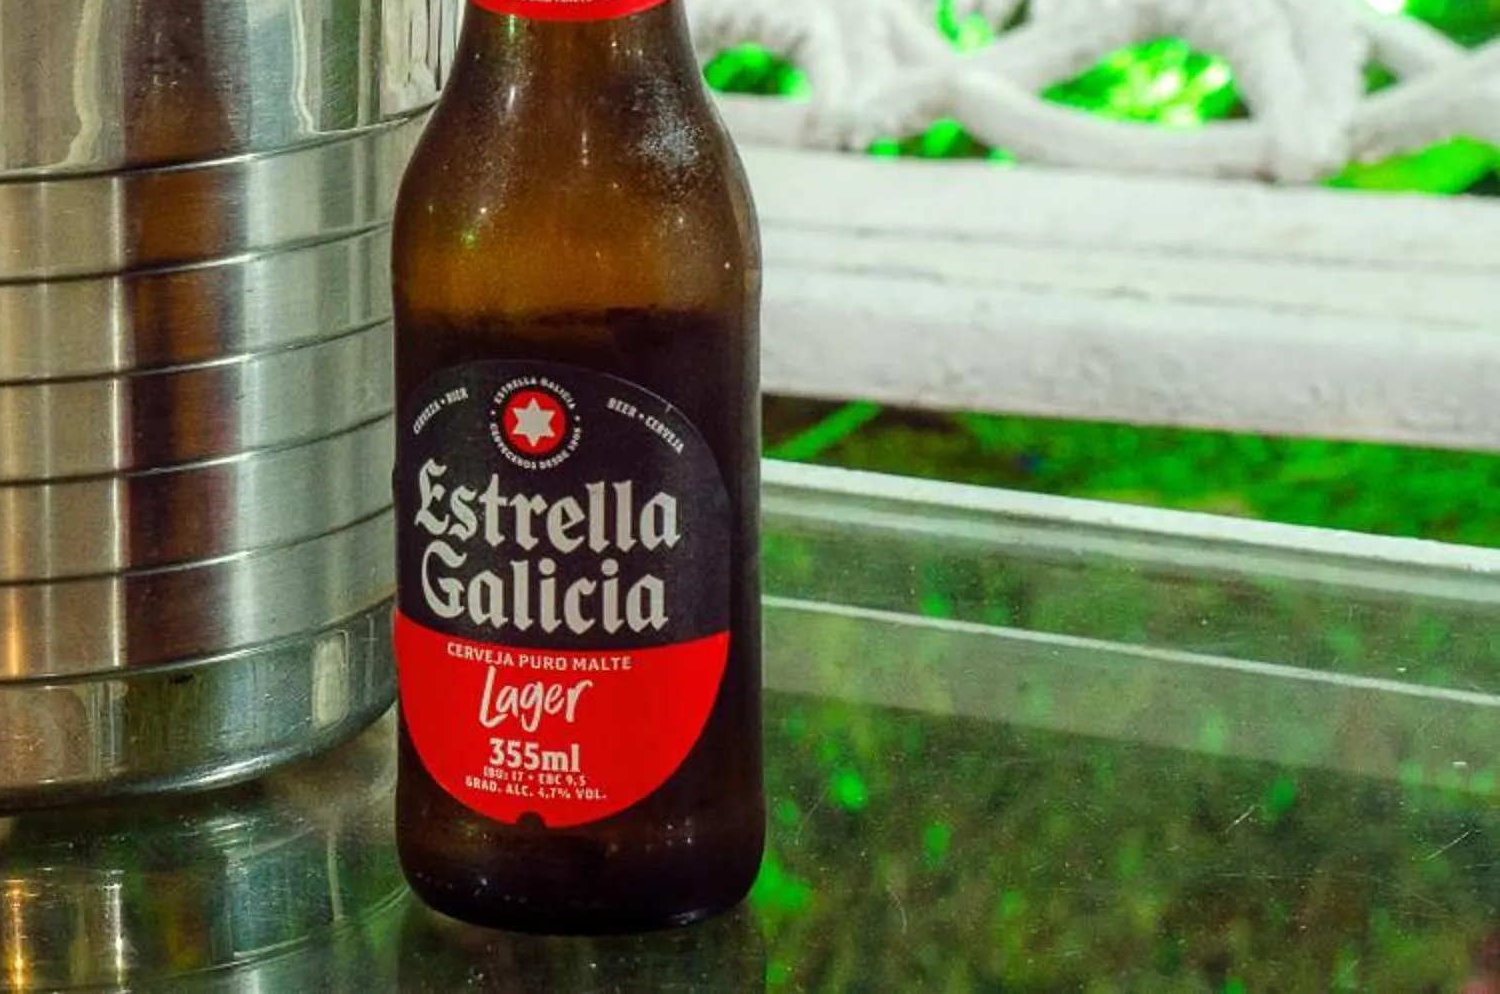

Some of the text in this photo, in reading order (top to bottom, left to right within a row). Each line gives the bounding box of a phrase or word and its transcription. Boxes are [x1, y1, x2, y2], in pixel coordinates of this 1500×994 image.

[607, 397, 684, 455] BEER CERVEJA
[415, 459, 681, 554] Estrella
[421, 540, 669, 635] Galicia
[447, 642, 632, 671] CERVEJA PURO MALTE
[478, 666, 593, 732] Lager
[488, 737, 580, 773] 355ml
[505, 783, 535, 797] ALC.
[575, 787, 608, 801] VOL.
